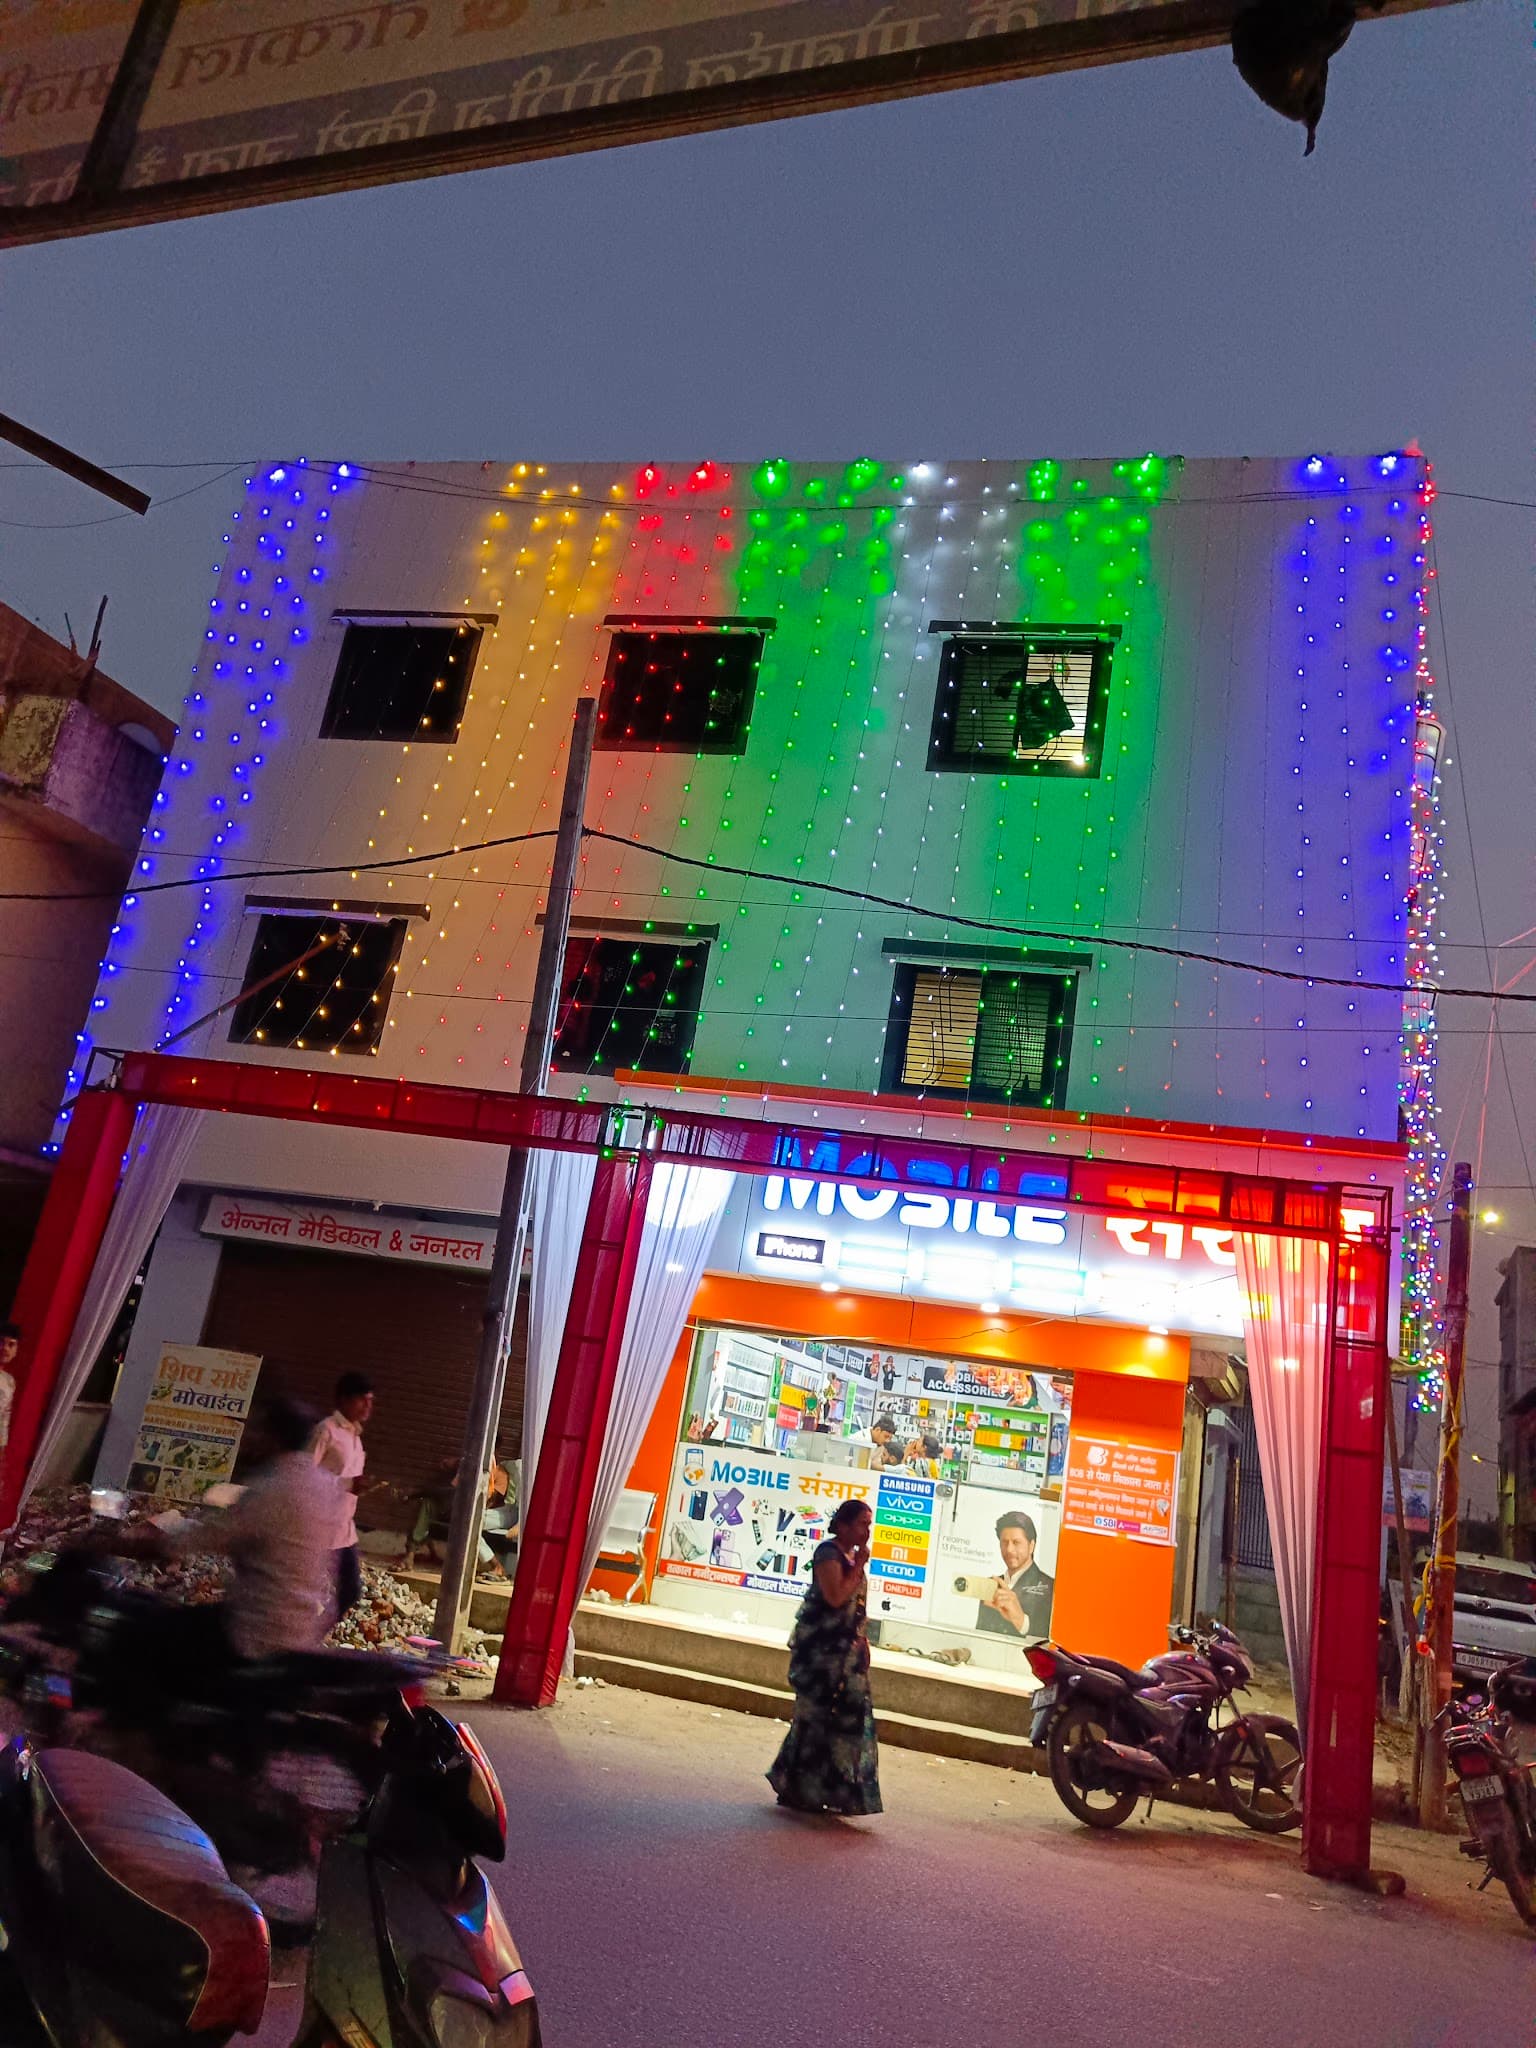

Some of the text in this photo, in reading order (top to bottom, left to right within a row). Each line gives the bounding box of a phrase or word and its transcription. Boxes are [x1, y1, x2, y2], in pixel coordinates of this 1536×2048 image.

[298, 1213, 382, 1249] मेडिकल
[389, 1230, 402, 1252] &
[410, 1233, 483, 1262] जनरल
[798, 1472, 870, 1500] संसार
[883, 1478, 931, 1494] SAMSUNG
[886, 1496, 924, 1511] vivo
[883, 1513, 923, 1525] oppo
[1103, 1518, 1116, 1527] SBI
[880, 1529, 922, 1544] realme
[881, 1563, 916, 1577] TECNO
[885, 1585, 921, 1596] ONEPLUS
